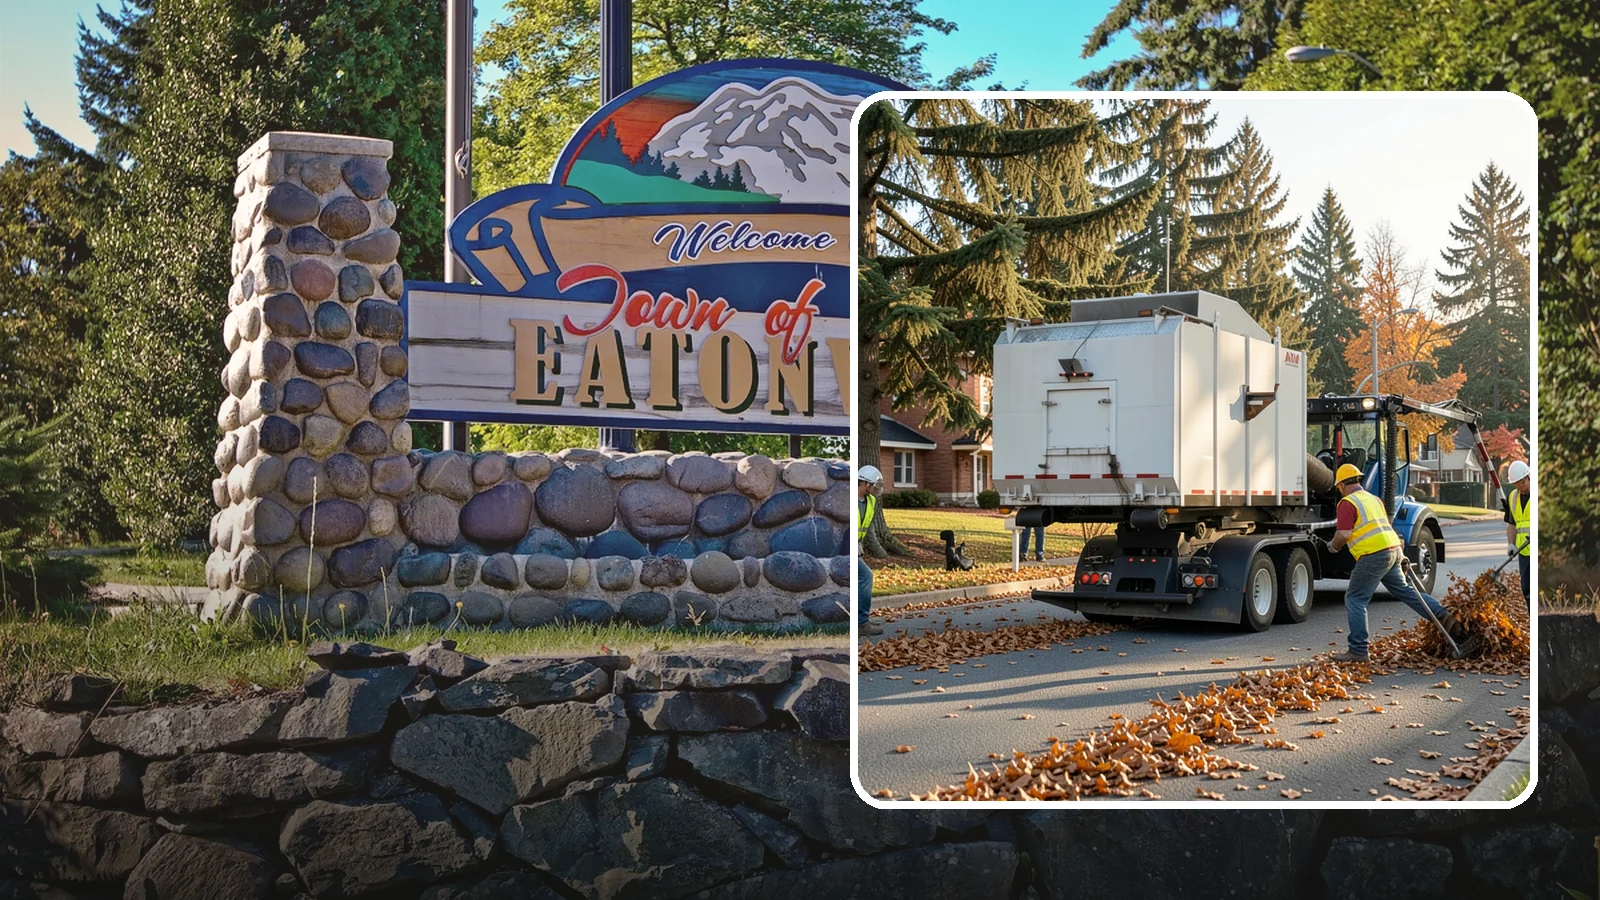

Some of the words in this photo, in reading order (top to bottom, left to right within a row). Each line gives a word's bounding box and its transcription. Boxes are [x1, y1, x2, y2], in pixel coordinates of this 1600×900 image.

[653, 221, 837, 263] Welcome
[557, 263, 737, 336] Town
[764, 278, 826, 366] of
